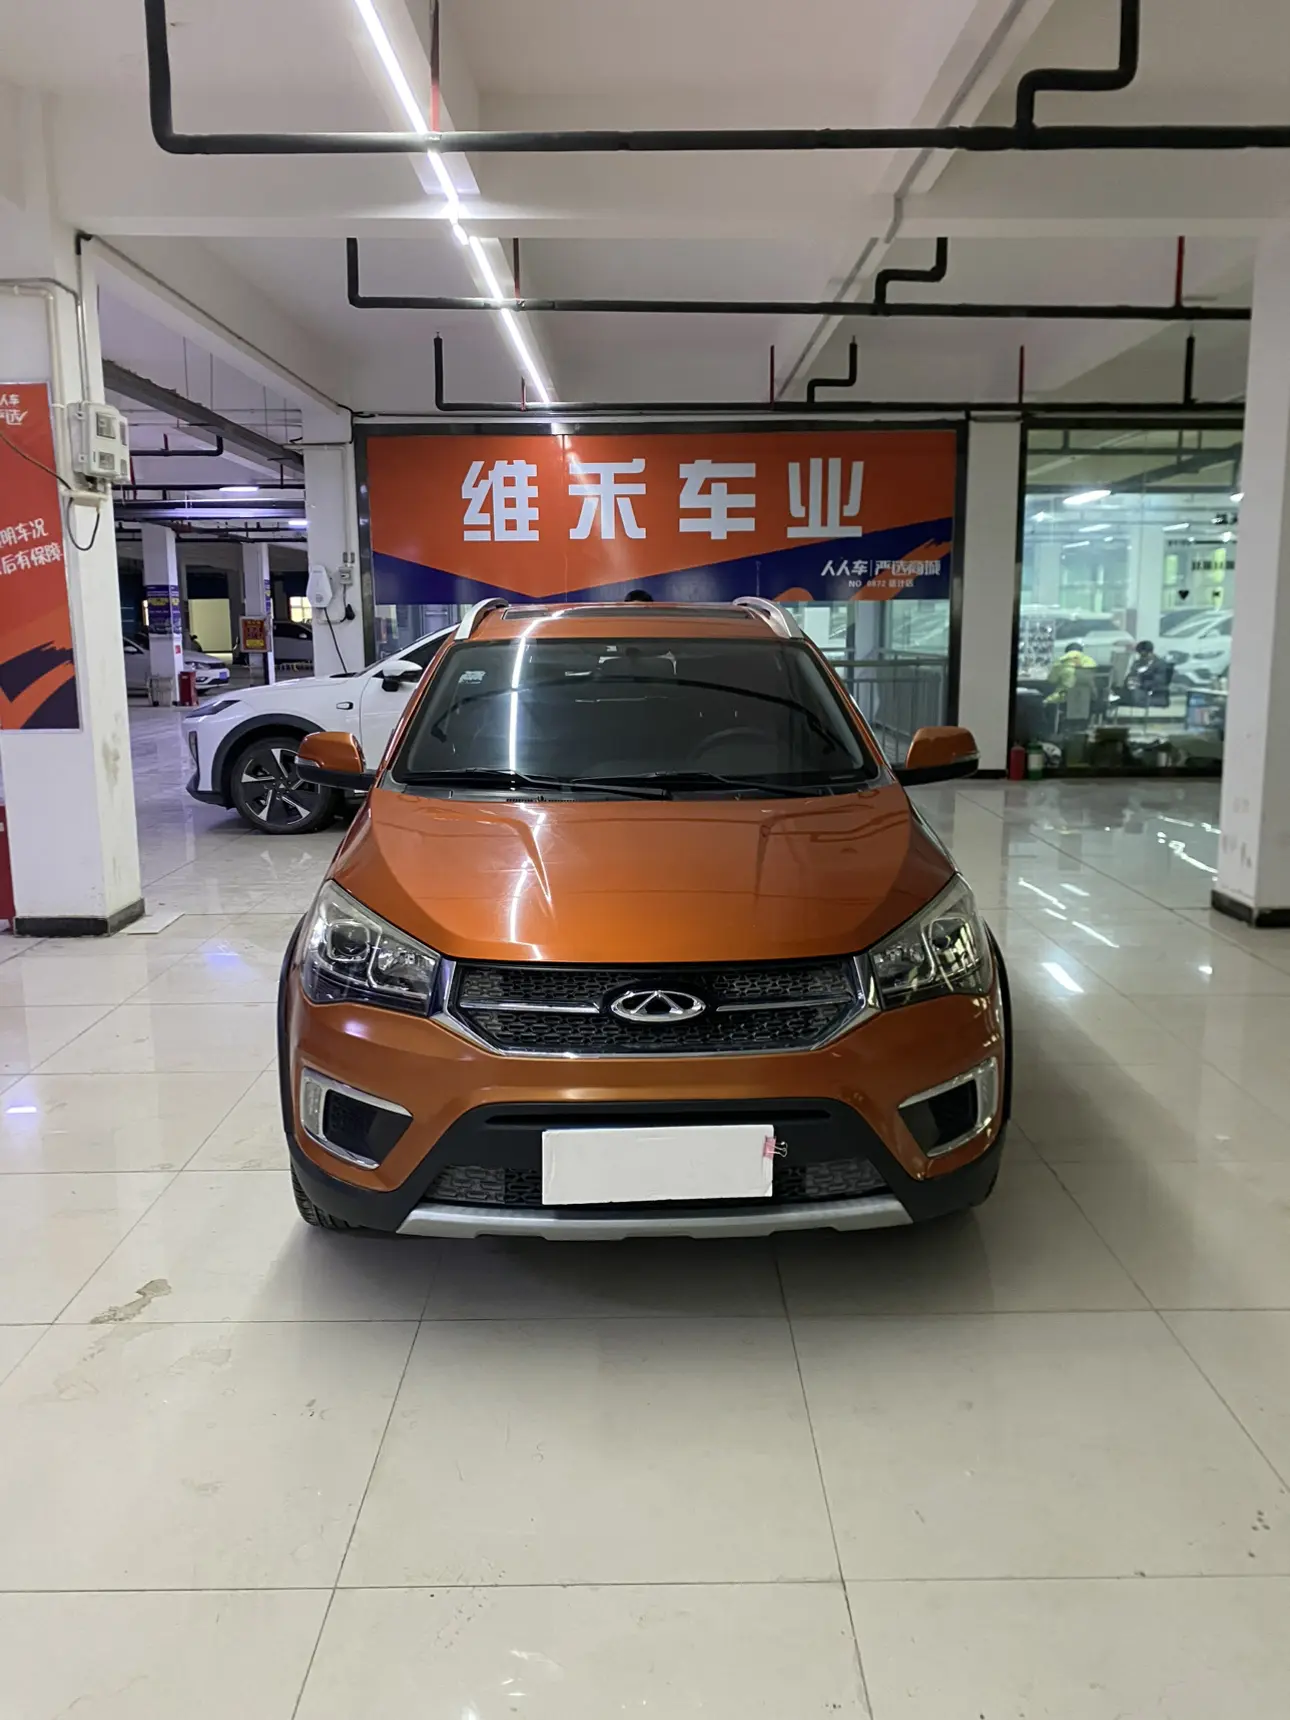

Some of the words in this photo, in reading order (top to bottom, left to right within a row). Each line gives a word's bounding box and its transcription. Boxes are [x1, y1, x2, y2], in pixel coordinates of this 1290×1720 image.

[461, 457, 865, 542] 维禾车业
[0, 517, 49, 549] 明车况
[0, 542, 62, 575] 后有保障
[821, 559, 868, 577] 人人车
